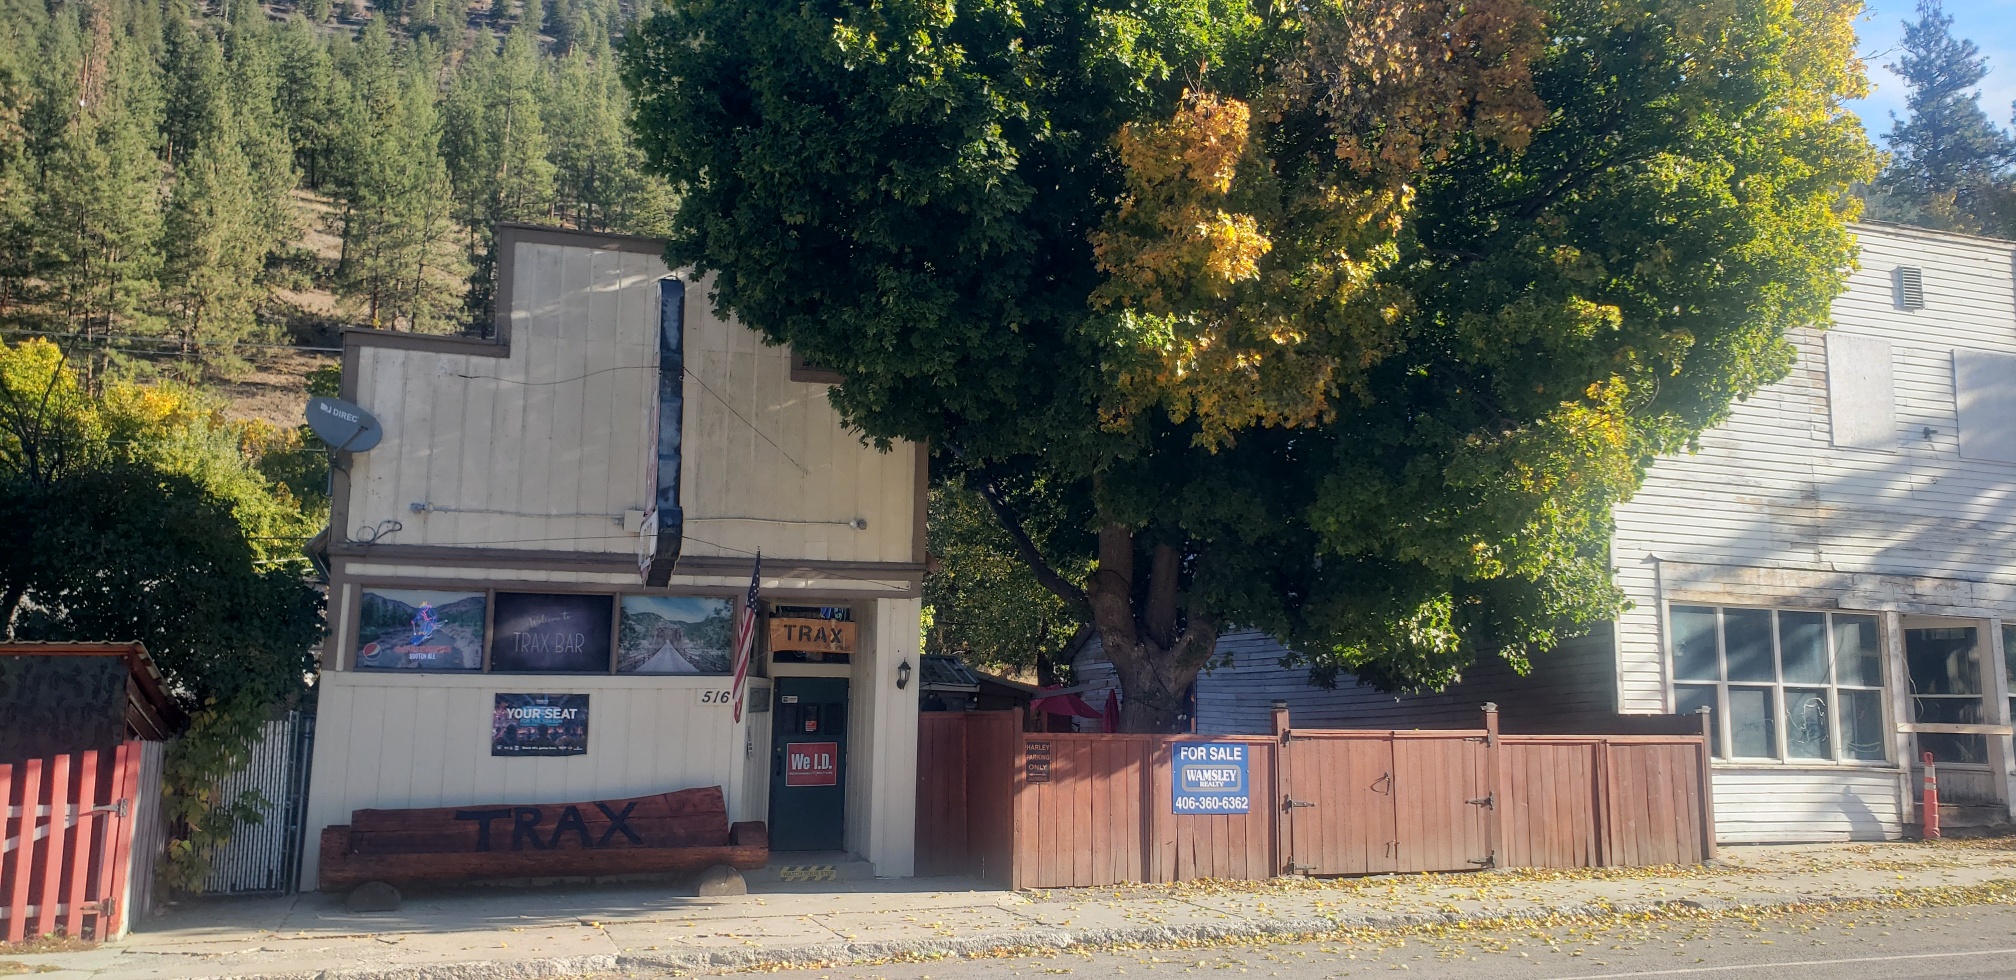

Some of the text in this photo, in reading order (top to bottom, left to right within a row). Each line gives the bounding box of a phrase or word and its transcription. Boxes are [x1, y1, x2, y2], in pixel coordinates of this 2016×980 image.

[333, 408, 359, 423] DIREC
[783, 624, 842, 644] TRAX
[513, 631, 585, 653] TRAX BAR
[701, 690, 731, 704] 516
[506, 708, 578, 720] YOUR SEAT
[1180, 746, 1242, 761] FOR SALE
[791, 753, 833, 770] We I.D.
[1028, 763, 1048, 771] ONLY
[1186, 769, 1237, 782] WAMSLEY
[1175, 796, 1249, 810] 406-360-6362
[455, 800, 645, 852] TRAX
